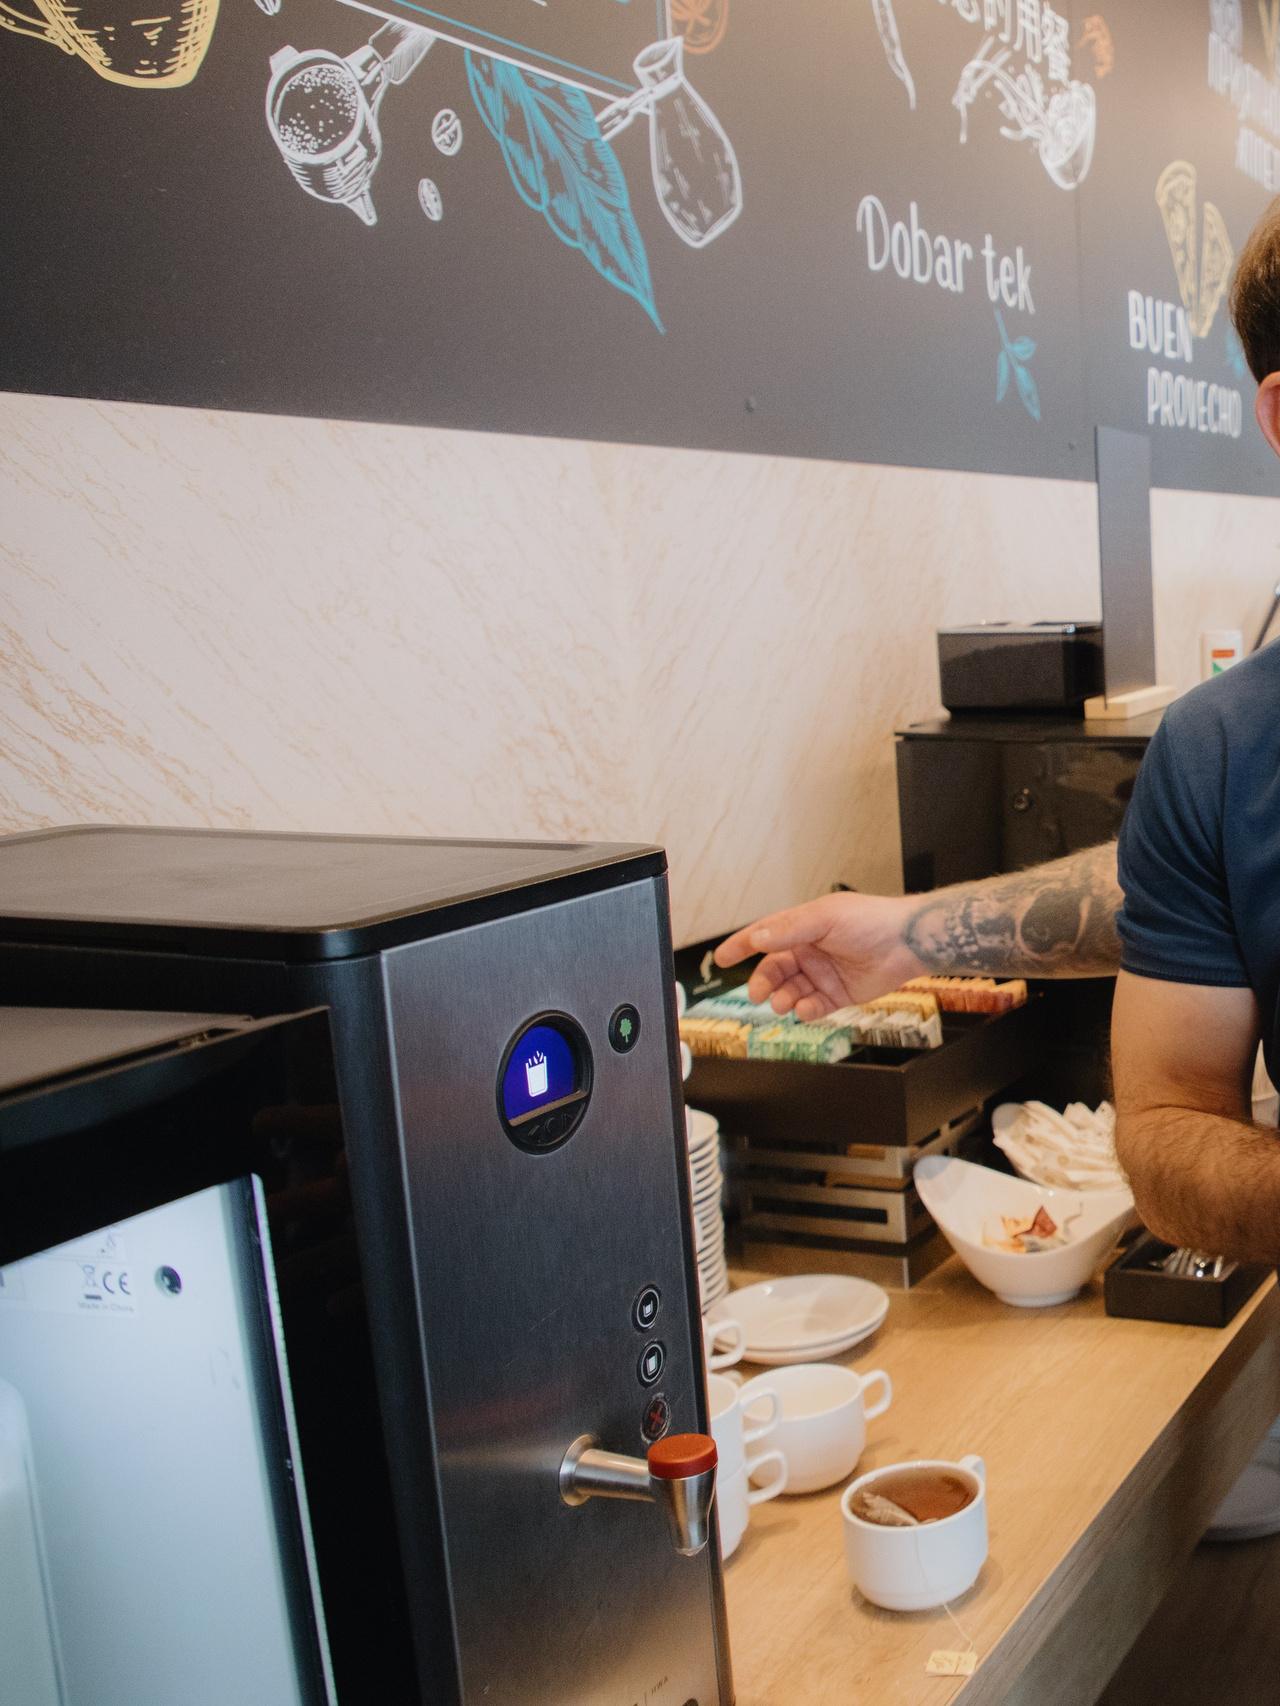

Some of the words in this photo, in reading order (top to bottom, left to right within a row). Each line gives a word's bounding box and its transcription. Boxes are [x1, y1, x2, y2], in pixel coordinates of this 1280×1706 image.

[856, 195, 974, 293] Dobar
[981, 232, 1036, 315] tek
[1128, 289, 1193, 363] BUEN
[1147, 366, 1242, 438] PROVECHO
